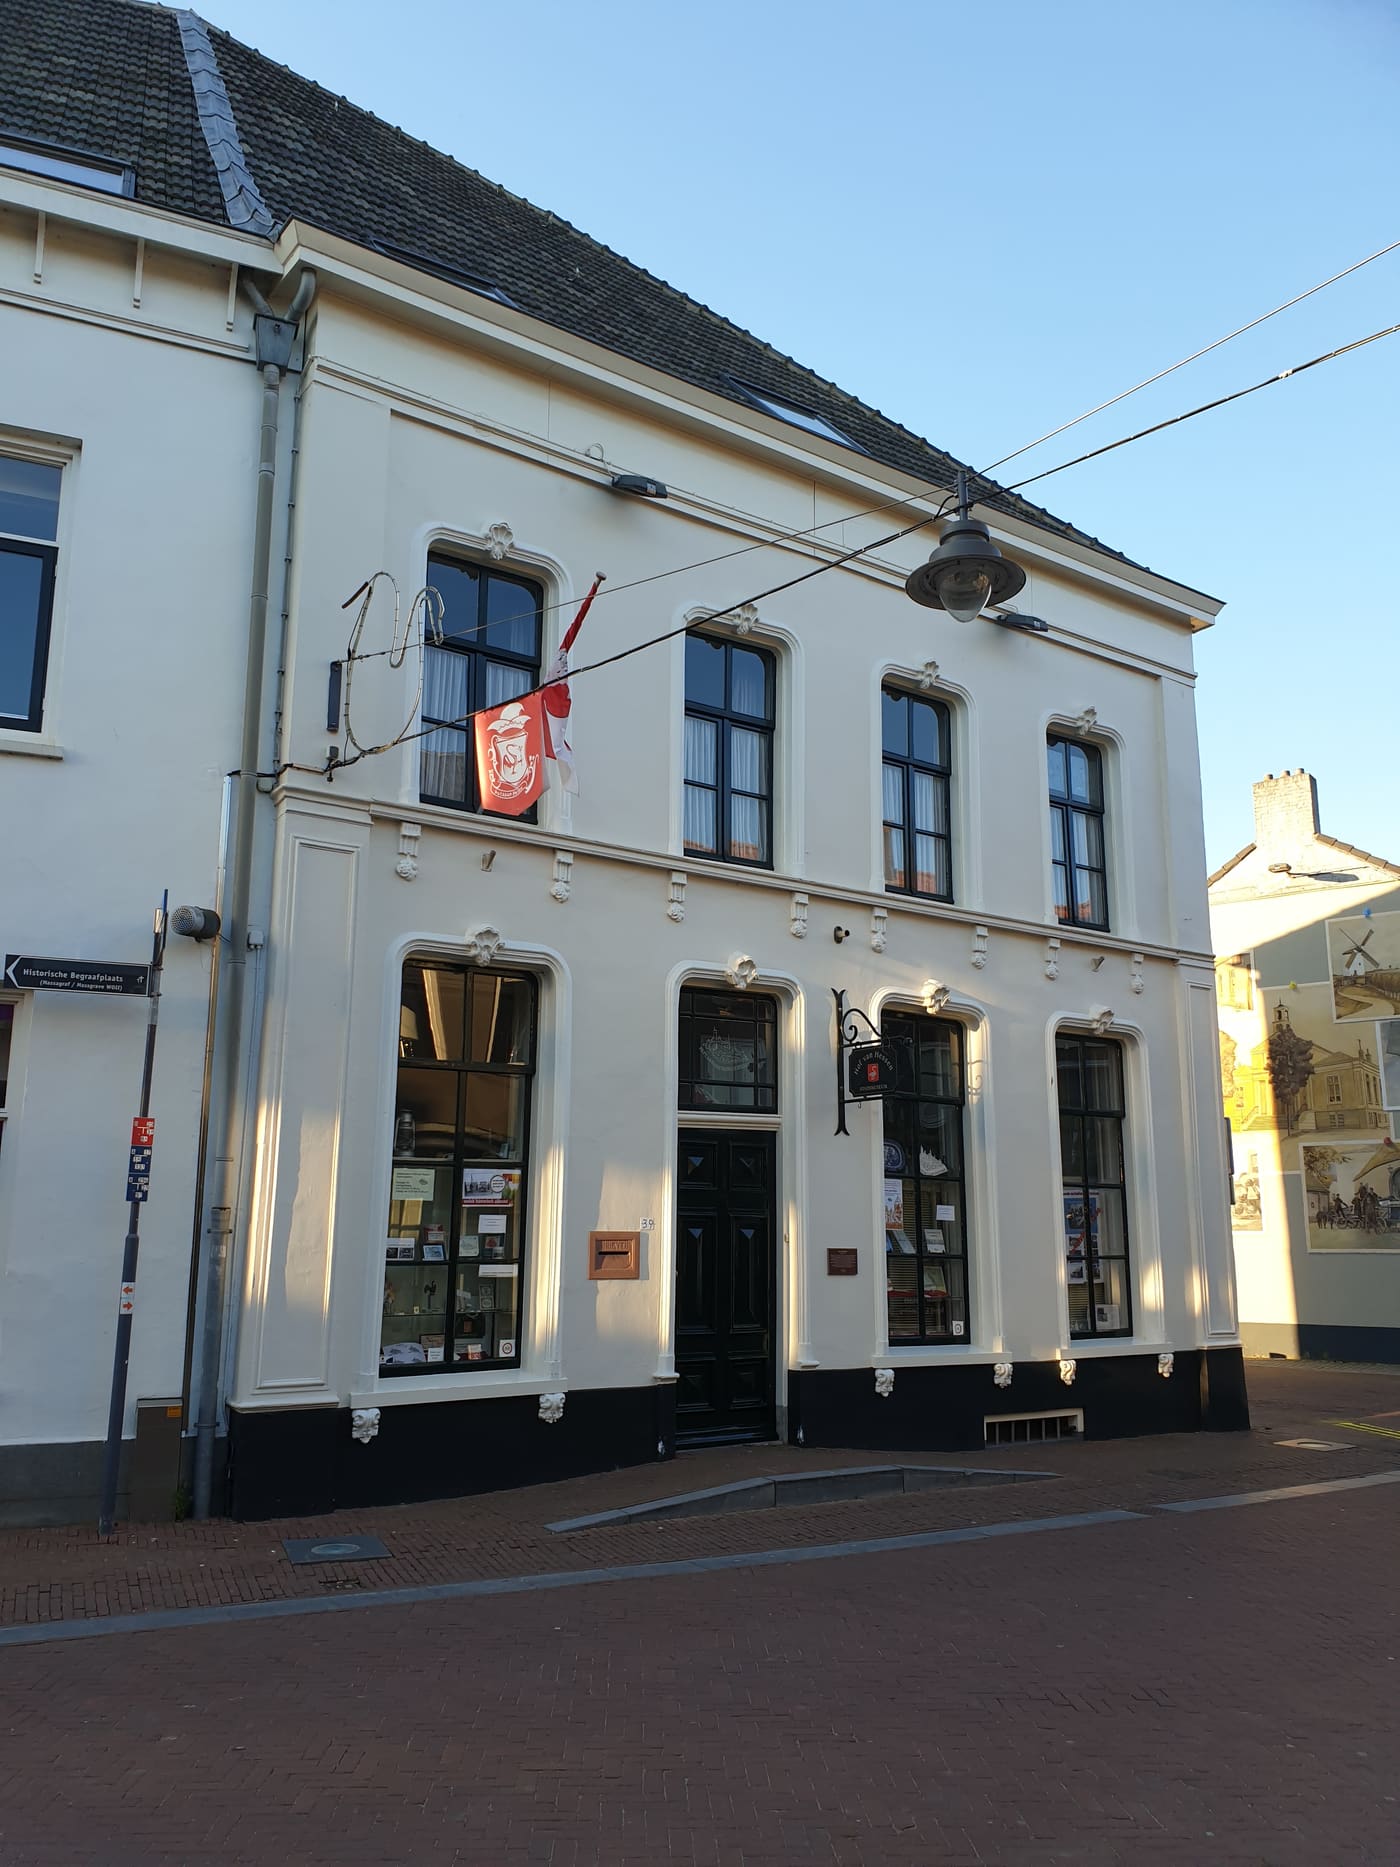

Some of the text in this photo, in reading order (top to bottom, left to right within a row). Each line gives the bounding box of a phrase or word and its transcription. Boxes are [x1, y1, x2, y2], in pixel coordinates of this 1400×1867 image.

[23, 968, 124, 982] Historische Begraafplaats
[641, 1219, 654, 1229] 39
